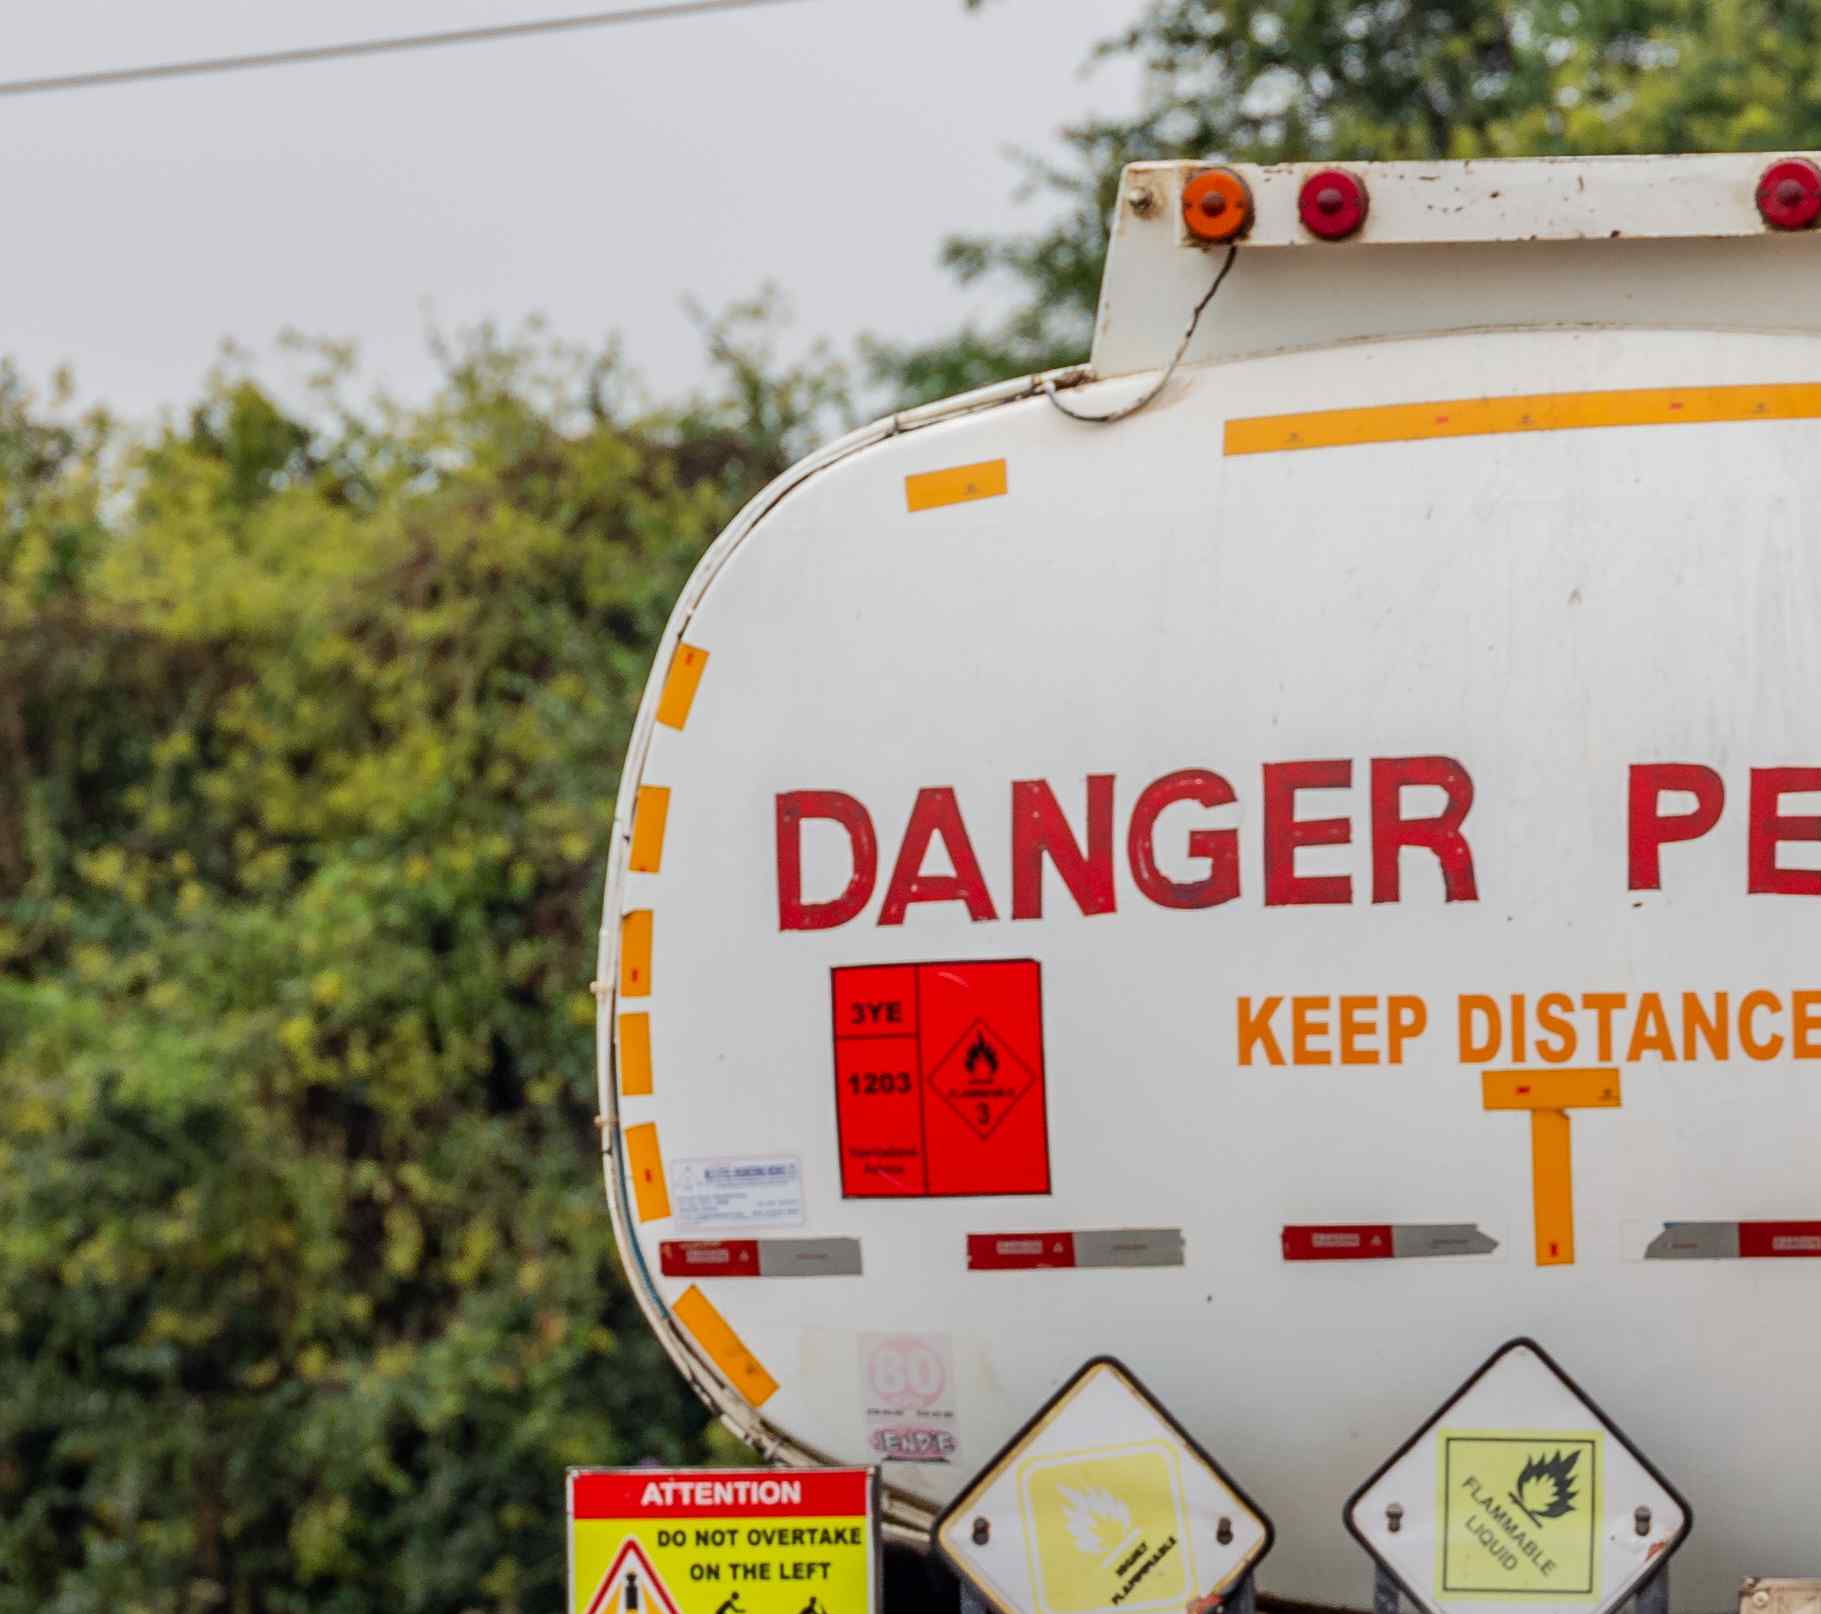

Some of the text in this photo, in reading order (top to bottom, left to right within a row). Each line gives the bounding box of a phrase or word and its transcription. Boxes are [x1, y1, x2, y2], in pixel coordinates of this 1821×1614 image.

[776, 756, 1479, 931] DANGER
[851, 1001, 903, 1024] 3YE
[1237, 995, 1427, 1066] KEEP
[849, 1072, 912, 1095] 1203
[976, 1102, 990, 1125] 3
[641, 1481, 801, 1506] ATTENTION
[657, 1528, 862, 1547] DO NOT OVERTAKE
[1462, 1476, 1558, 1576] FLAMMABLE
[1465, 1515, 1518, 1571] LIQUID
[690, 1562, 831, 1580] ON THE LEFT
